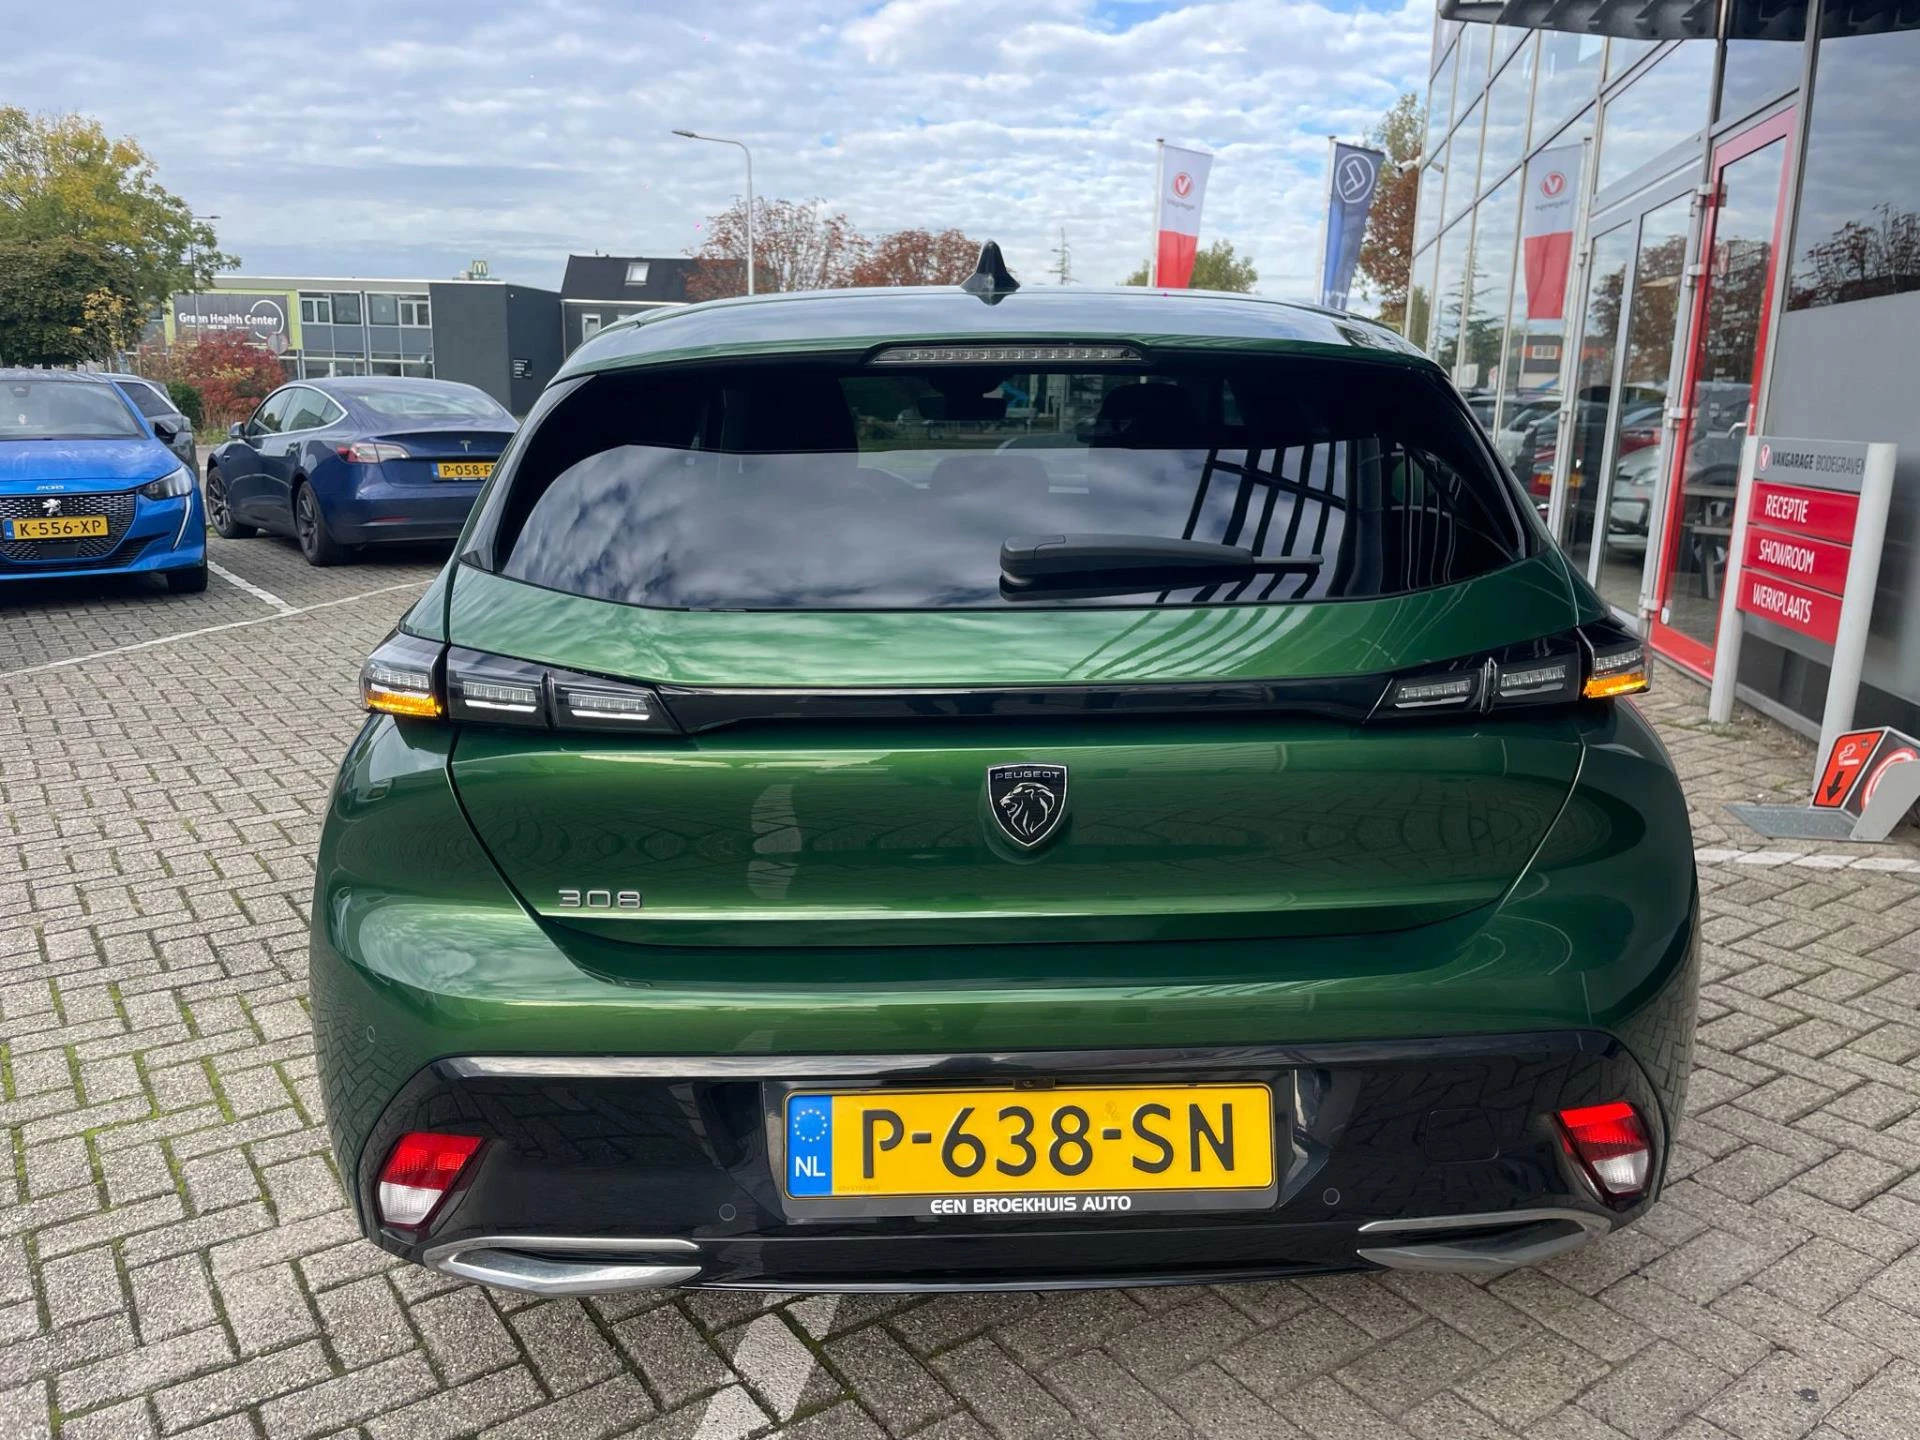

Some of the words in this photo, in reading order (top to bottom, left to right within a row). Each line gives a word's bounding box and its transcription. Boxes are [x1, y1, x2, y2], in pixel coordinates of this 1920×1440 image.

[178, 312, 208, 324] Green
[210, 313, 243, 325] Health
[244, 314, 278, 326] Center
[443, 464, 495, 476] P-058-F
[1765, 494, 1809, 523] RECEPTIE
[20, 519, 101, 537] K-556-XP
[1758, 538, 1815, 574] SHOWROOM
[1752, 582, 1813, 624] WERKPLAATS
[995, 770, 1061, 780] PEUGEOT
[558, 889, 642, 909] 308
[794, 1155, 826, 1178] NL
[861, 1103, 1235, 1179] P-638-SN
[929, 1199, 967, 1214] EEN
[972, 1196, 1077, 1213] BROEKHUIS
[1082, 1195, 1132, 1212] AUTO
